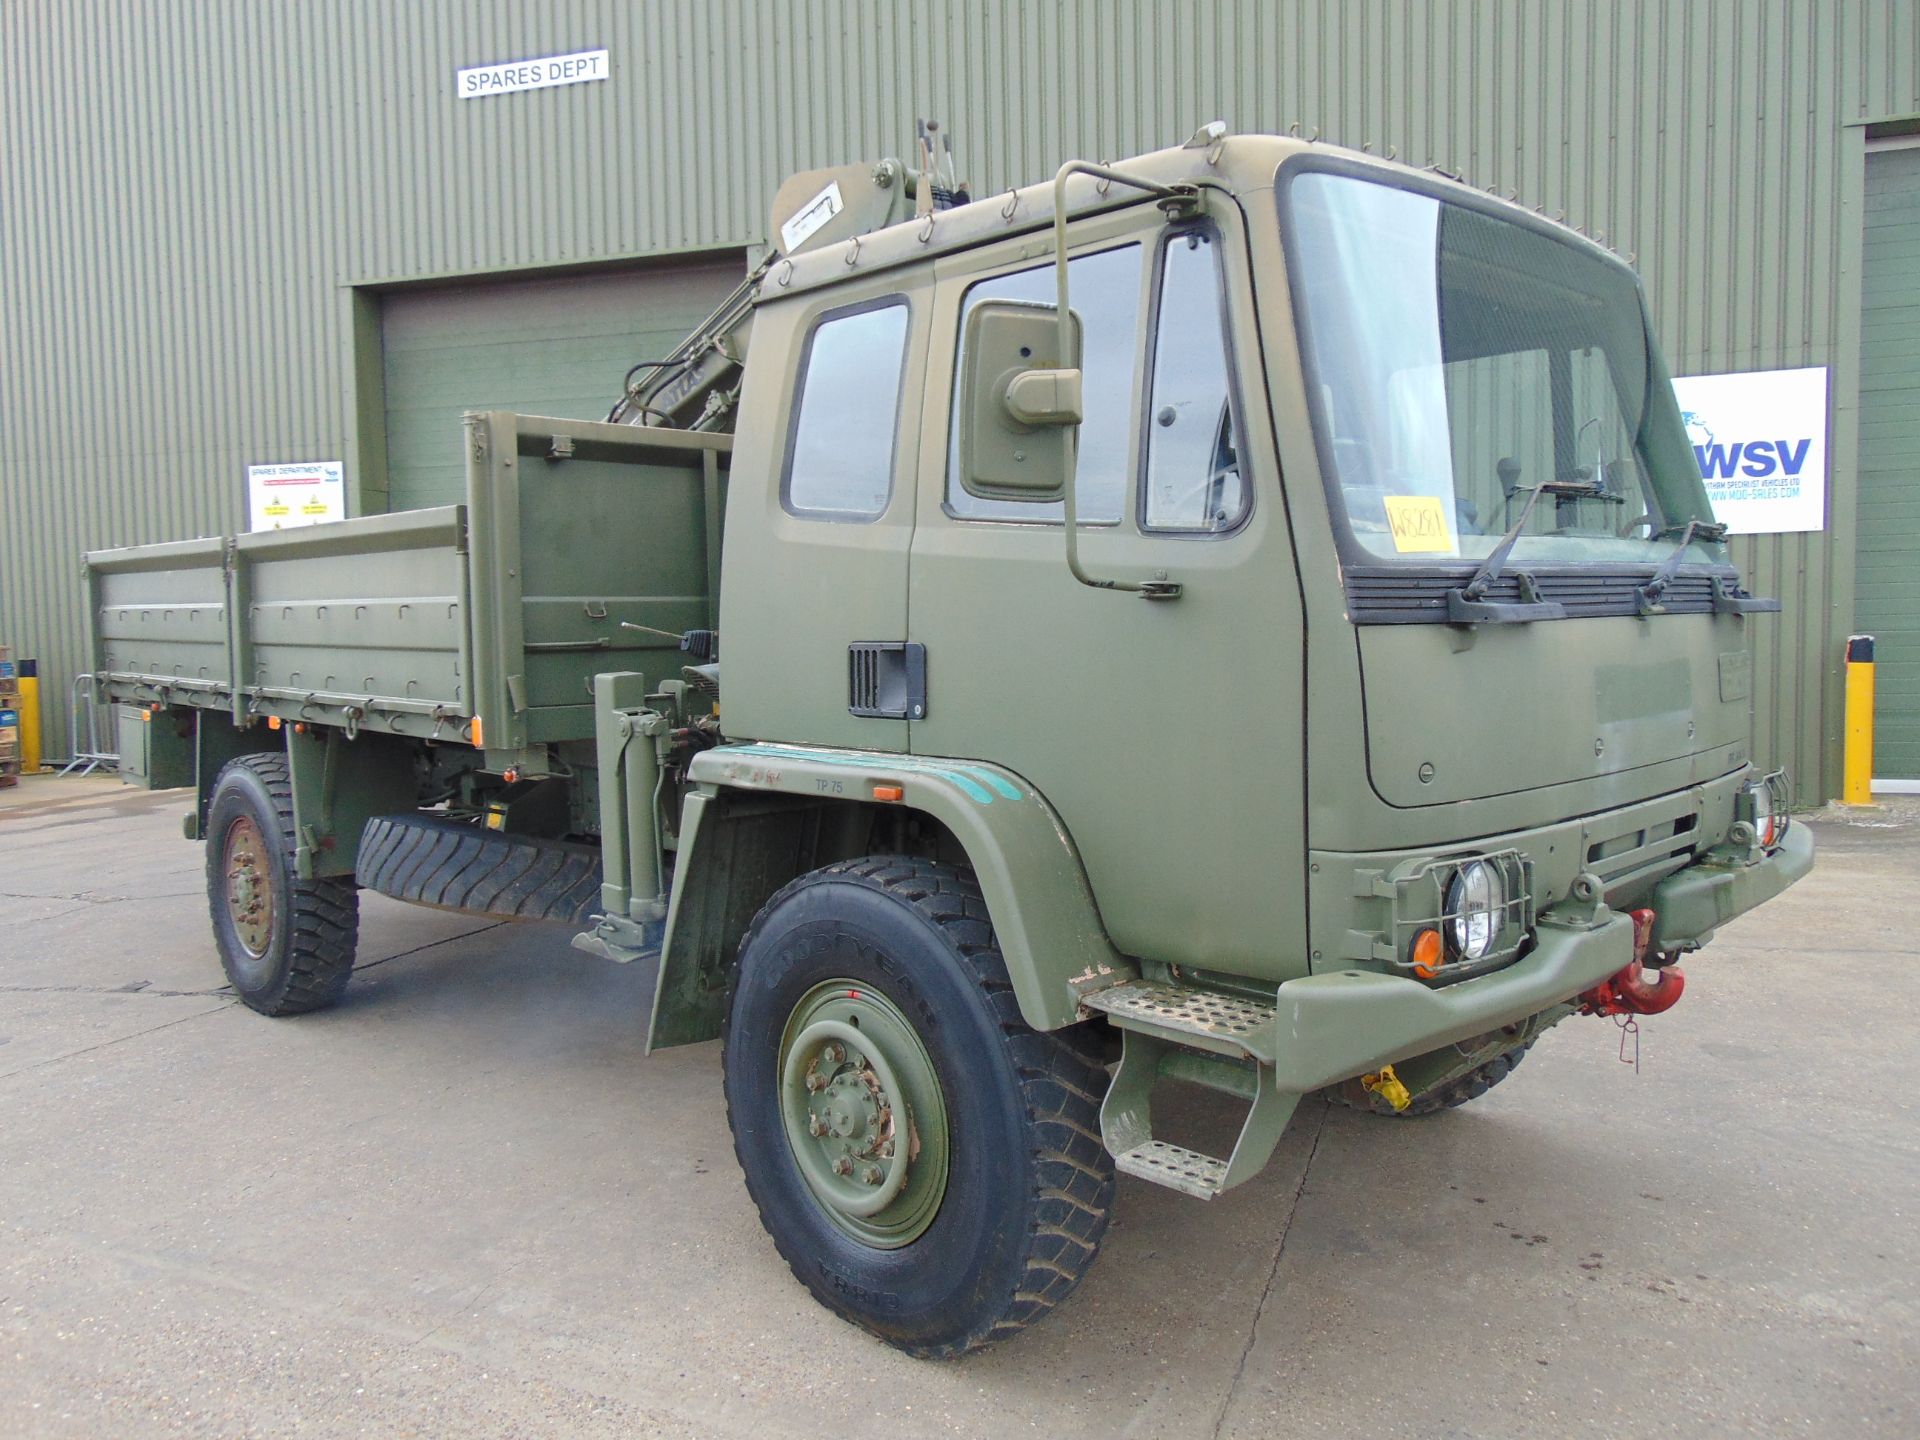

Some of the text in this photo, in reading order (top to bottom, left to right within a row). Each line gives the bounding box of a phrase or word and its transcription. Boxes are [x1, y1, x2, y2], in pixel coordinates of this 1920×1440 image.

[466, 56, 600, 92] SPARES DEPT
[1693, 438, 1812, 479] WSV
[1727, 480, 1759, 489] SPECIALIST
[1761, 478, 1788, 488] VEHICLES
[1789, 477, 1800, 486] LTD
[1387, 507, 1443, 538] W8281
[815, 778, 844, 794] TP 75
